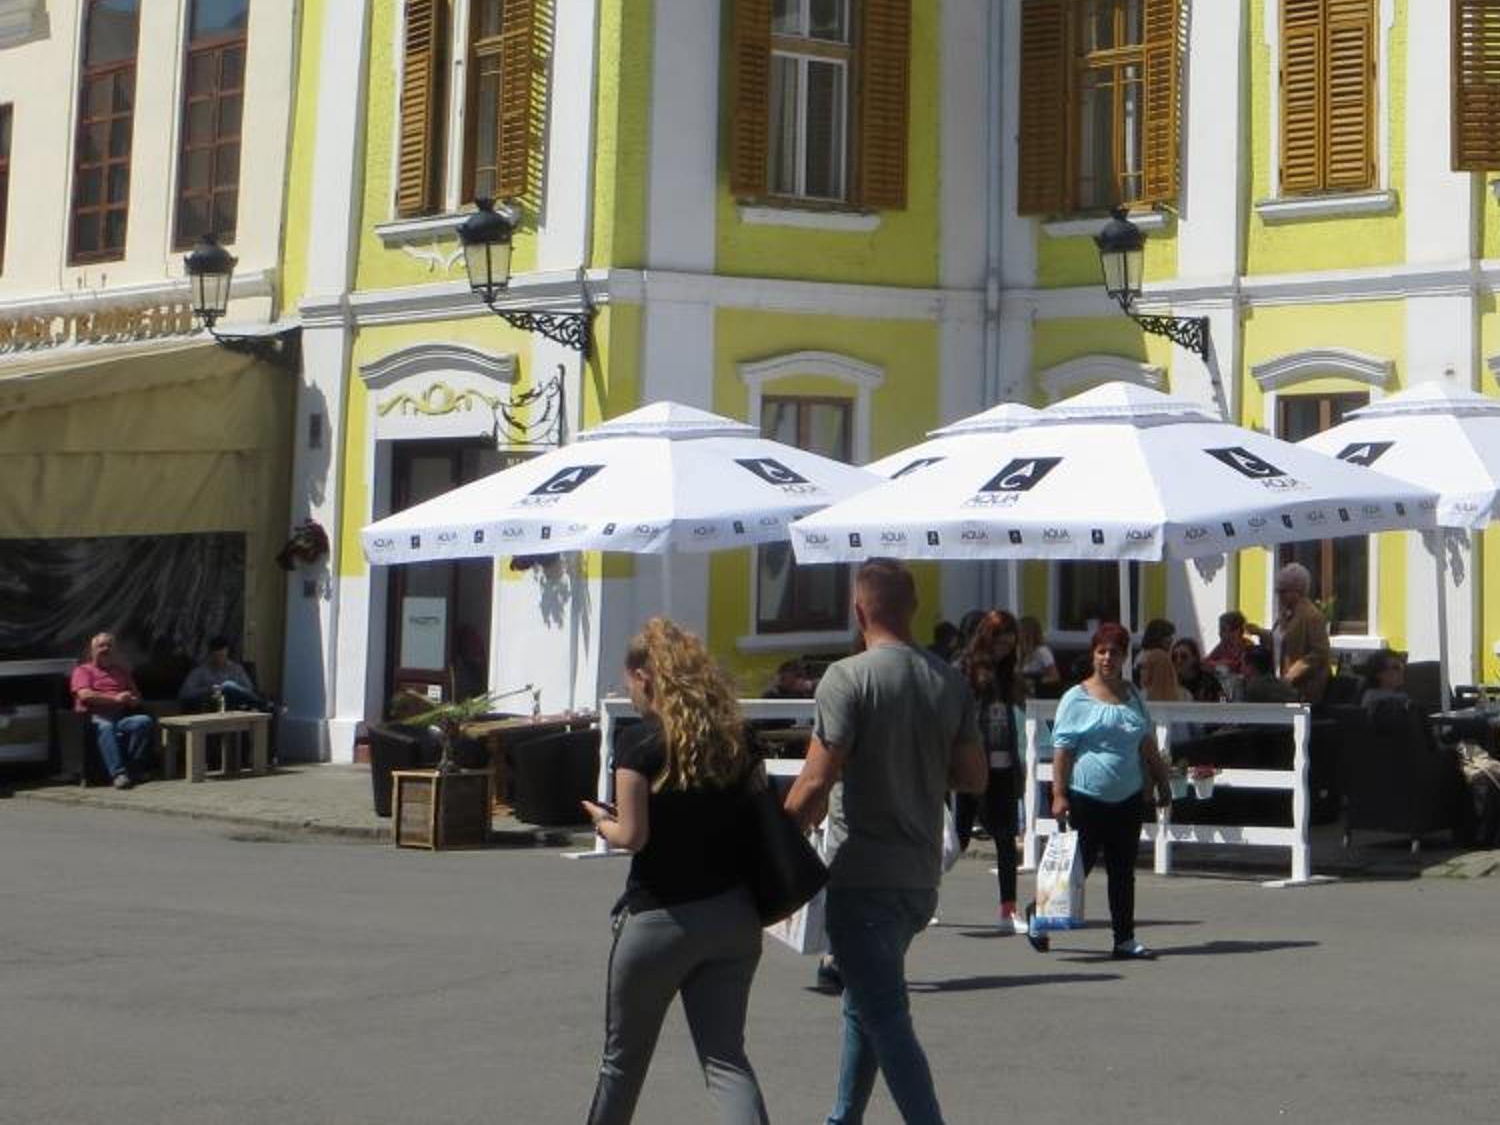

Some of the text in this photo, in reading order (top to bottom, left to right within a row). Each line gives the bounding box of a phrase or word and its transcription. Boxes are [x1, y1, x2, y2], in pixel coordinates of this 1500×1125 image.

[805, 533, 831, 545] AQUA
[881, 530, 908, 543] AQUA
[960, 530, 990, 542] AQUA
[1042, 529, 1070, 541] AQUA
[1125, 529, 1154, 540] AQUA
